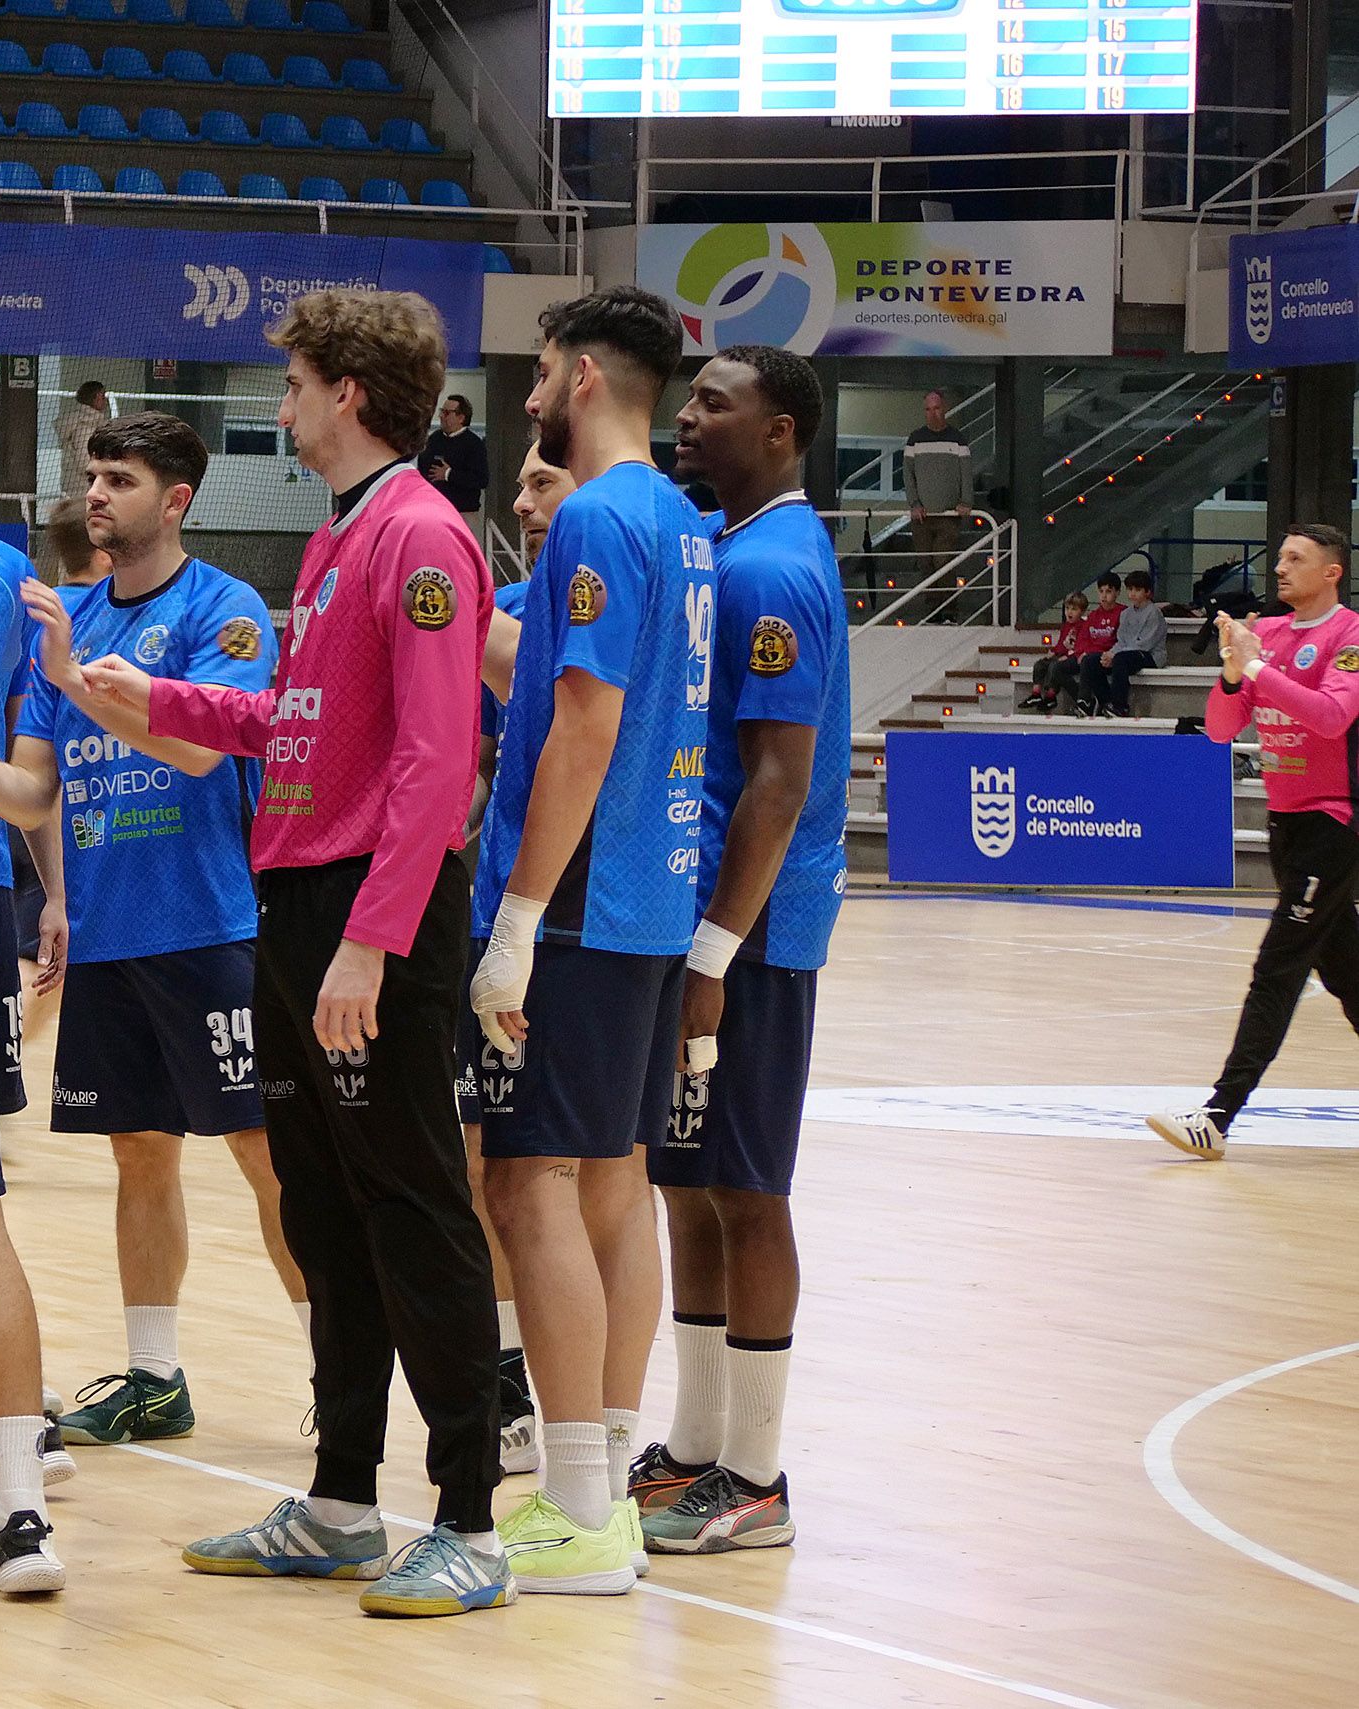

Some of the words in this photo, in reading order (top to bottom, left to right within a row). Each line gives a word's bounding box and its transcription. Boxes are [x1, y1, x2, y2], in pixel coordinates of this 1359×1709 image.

[1002, 19, 1024, 42] 14
[1103, 18, 1126, 41] 15
[659, 56, 681, 79] 17
[1001, 54, 1023, 76] 16
[1103, 52, 1125, 75] 17
[1102, 86, 1123, 109] 19
[843, 116, 902, 128] MONDO
[855, 259, 1013, 276] DEPORTE
[855, 286, 1086, 303] PONTEVEDRA
[1280, 278, 1329, 298] Concello
[855, 311, 1008, 326] deportes.pontevedra.gal
[1282, 302, 1298, 319] de
[90, 767, 171, 800] OVIEDO
[1026, 794, 1095, 815] Concello
[112, 803, 181, 829] Asturias
[1026, 818, 1047, 837] de
[1050, 818, 1142, 838] Pontevedra
[206, 1007, 256, 1057] 34
